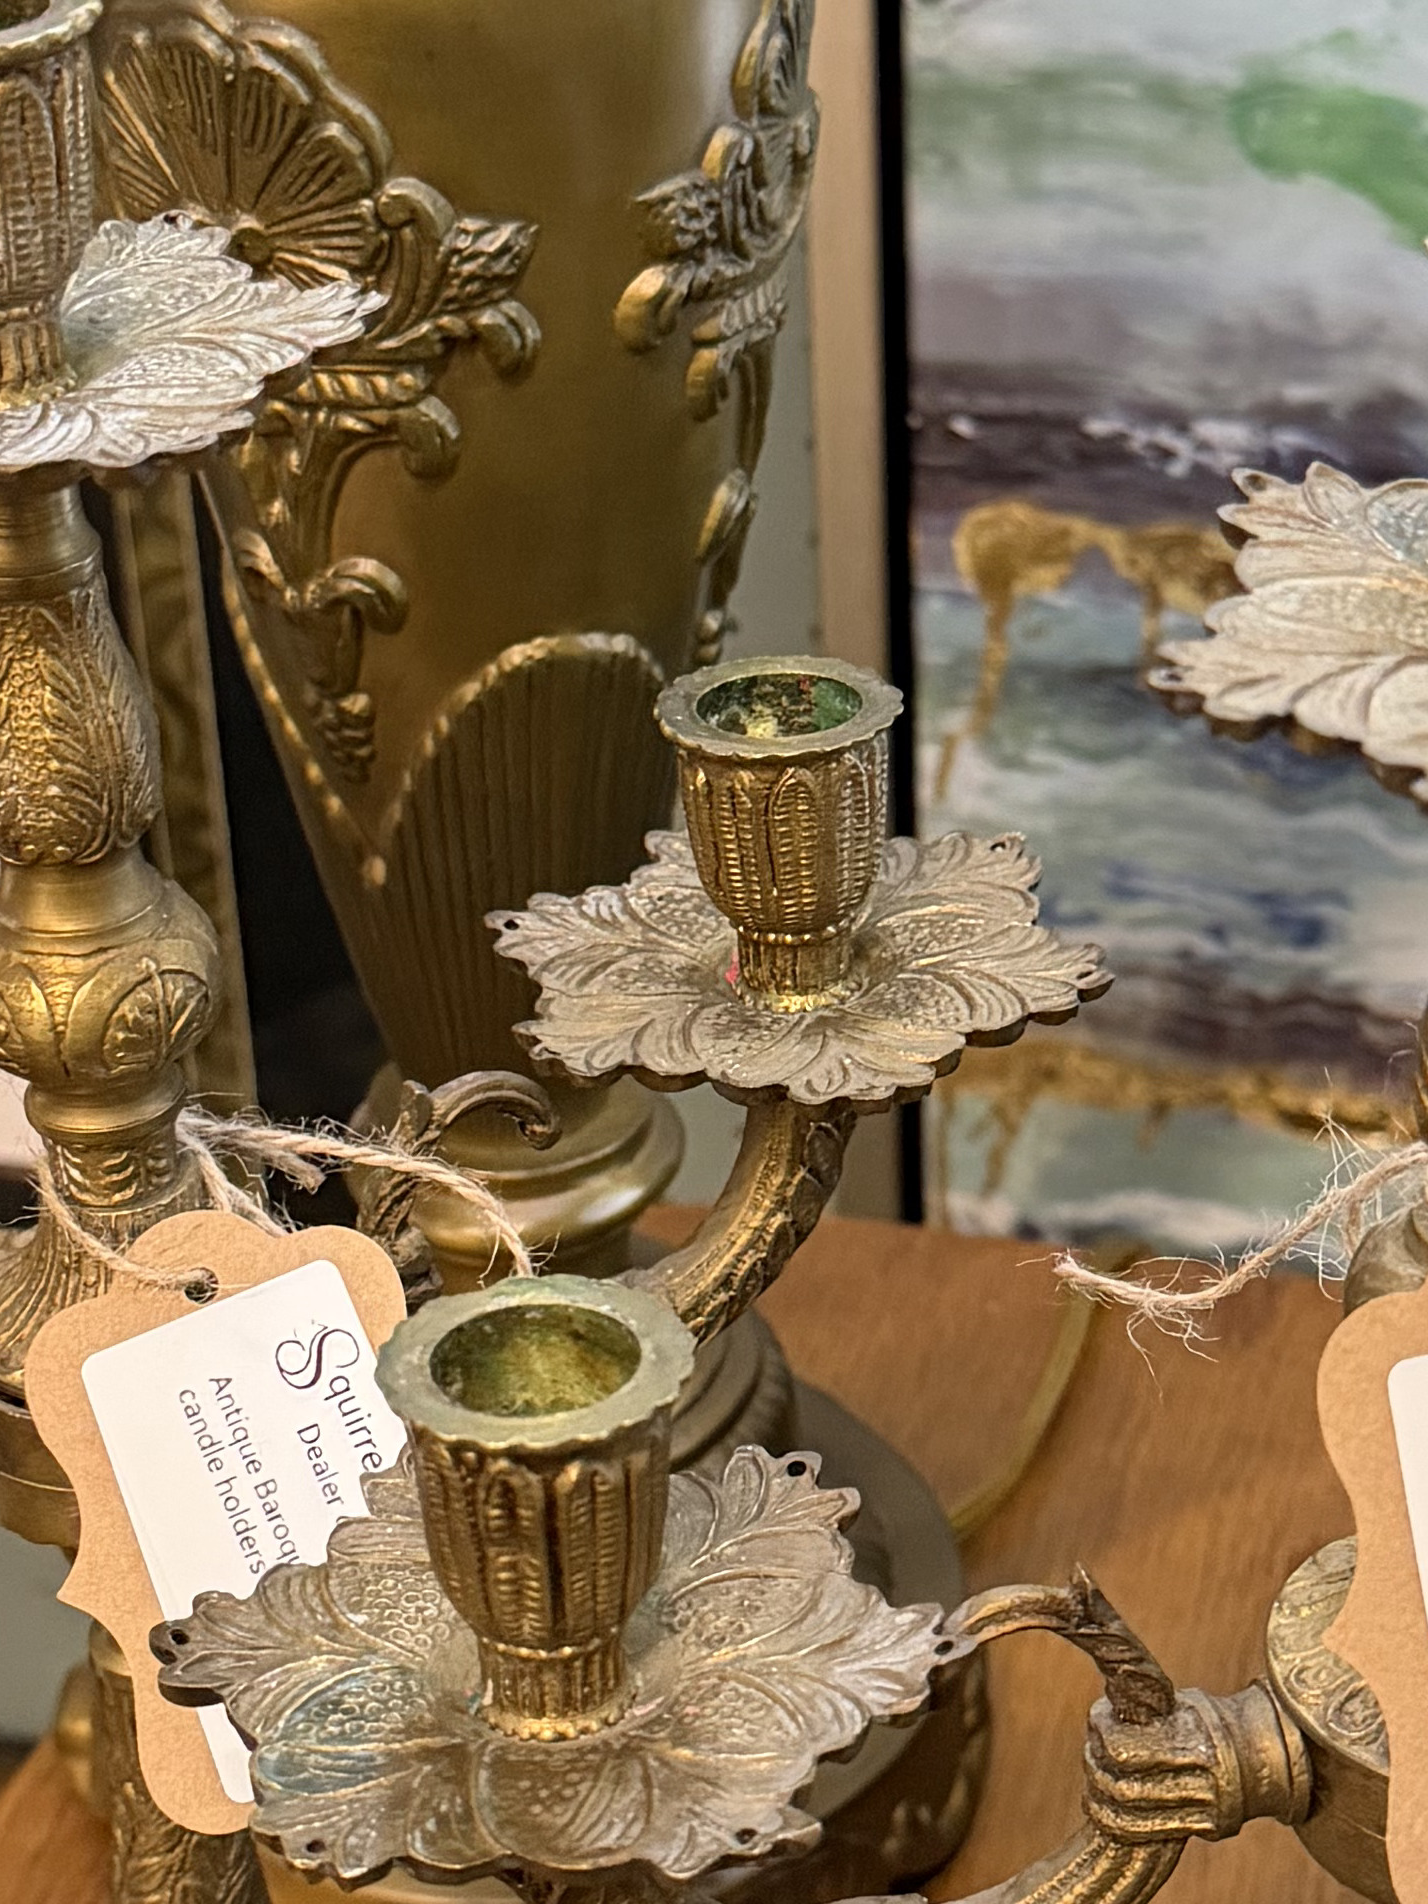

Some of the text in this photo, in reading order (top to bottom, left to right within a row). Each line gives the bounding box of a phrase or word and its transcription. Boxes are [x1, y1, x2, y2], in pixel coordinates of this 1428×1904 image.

[208, 1377, 262, 1475] Antique
[275, 1326, 383, 1472] Squirre
[179, 1389, 266, 1575] candle holders
[297, 1423, 344, 1505] Dealer
